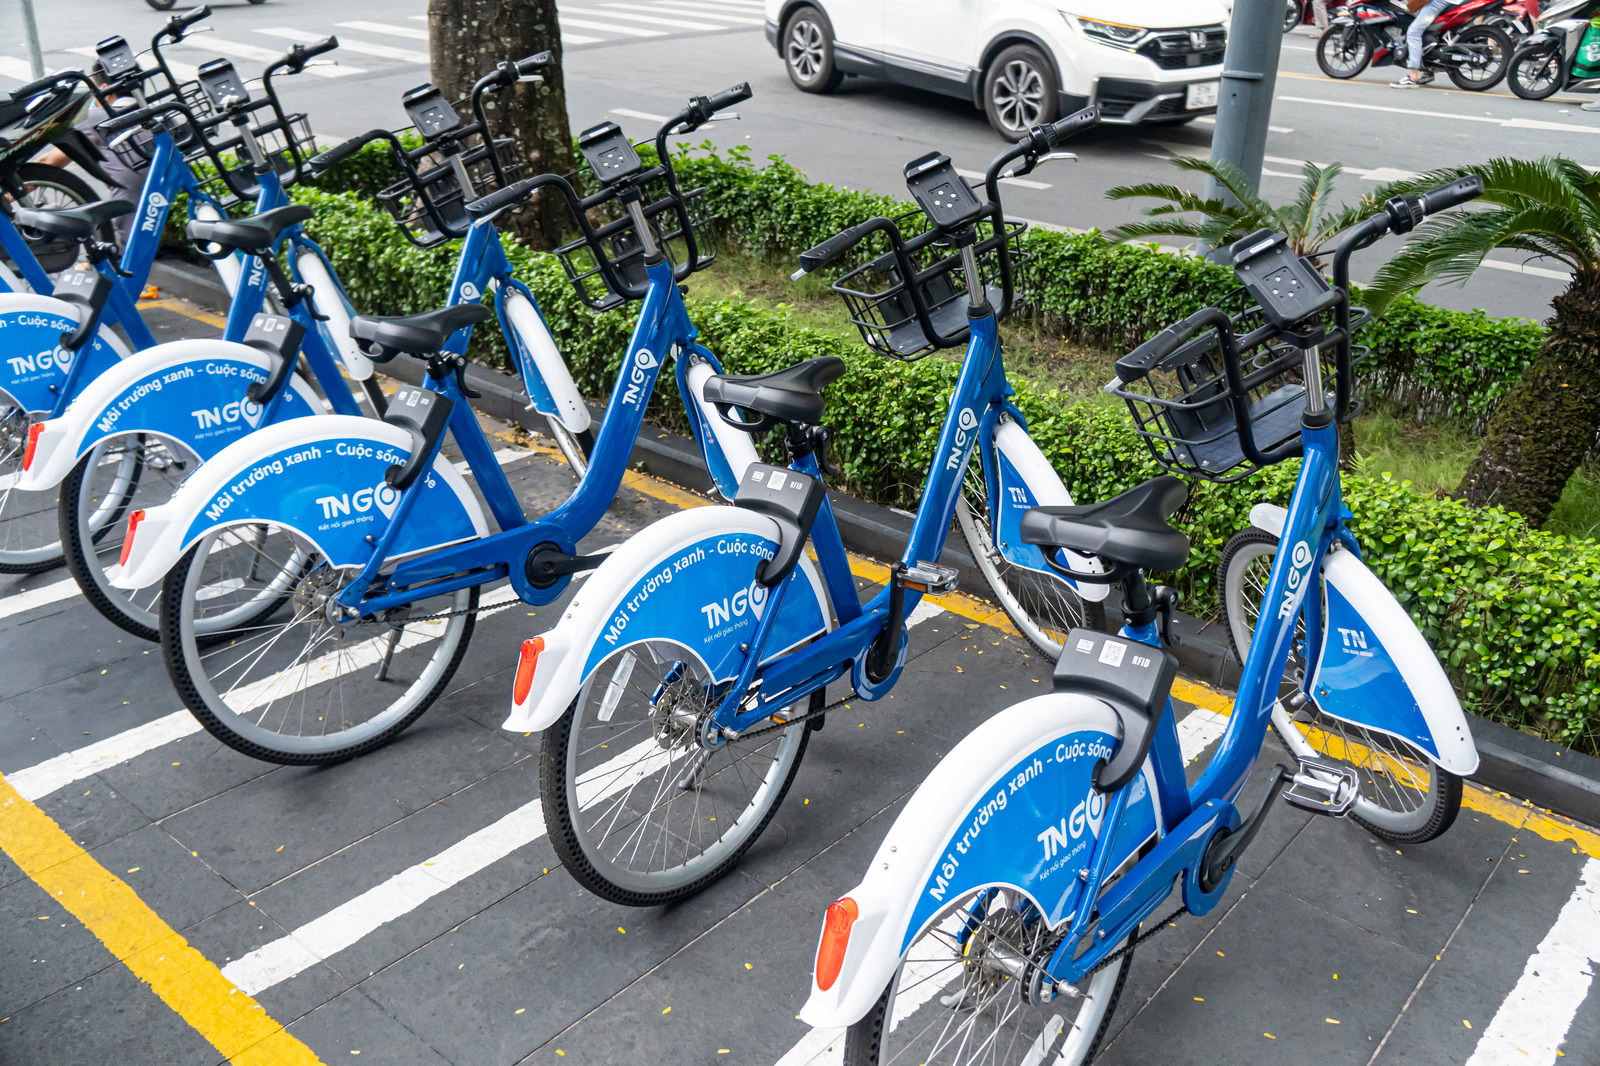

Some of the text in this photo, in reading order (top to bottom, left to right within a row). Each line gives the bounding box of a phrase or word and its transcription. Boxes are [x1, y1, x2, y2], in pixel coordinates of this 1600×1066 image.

[142, 192, 169, 232] TNGO
[247, 255, 265, 286] TNG
[18, 315, 48, 328] Cuộc
[7, 345, 75, 375] TNGO
[622, 348, 659, 405] TNGO
[97, 407, 122, 432] Môi
[120, 377, 163, 411] trường
[162, 366, 194, 384] xanh
[206, 363, 238, 378] Cuộc
[192, 395, 264, 430] TNGO
[946, 407, 979, 471] TNGO
[205, 492, 235, 522] Môi
[231, 459, 284, 496] trường
[284, 446, 322, 467] xanh
[335, 443, 373, 459] Cuộc
[315, 480, 402, 520] TNGO
[1007, 487, 1028, 503] TN
[604, 615, 630, 646] Môi
[626, 567, 673, 613] trường
[674, 547, 706, 574] xanh
[717, 538, 748, 557] Cuộc
[1278, 540, 1313, 620] TNGO
[701, 579, 769, 629] TNGO
[1337, 627, 1368, 649] TN
[1131, 655, 1151, 668] RFID
[929, 853, 960, 901] Môi
[956, 789, 1008, 855] trường
[1008, 758, 1044, 794] xanh
[1055, 738, 1086, 763] Cuộc
[1036, 786, 1106, 862] TNGO
